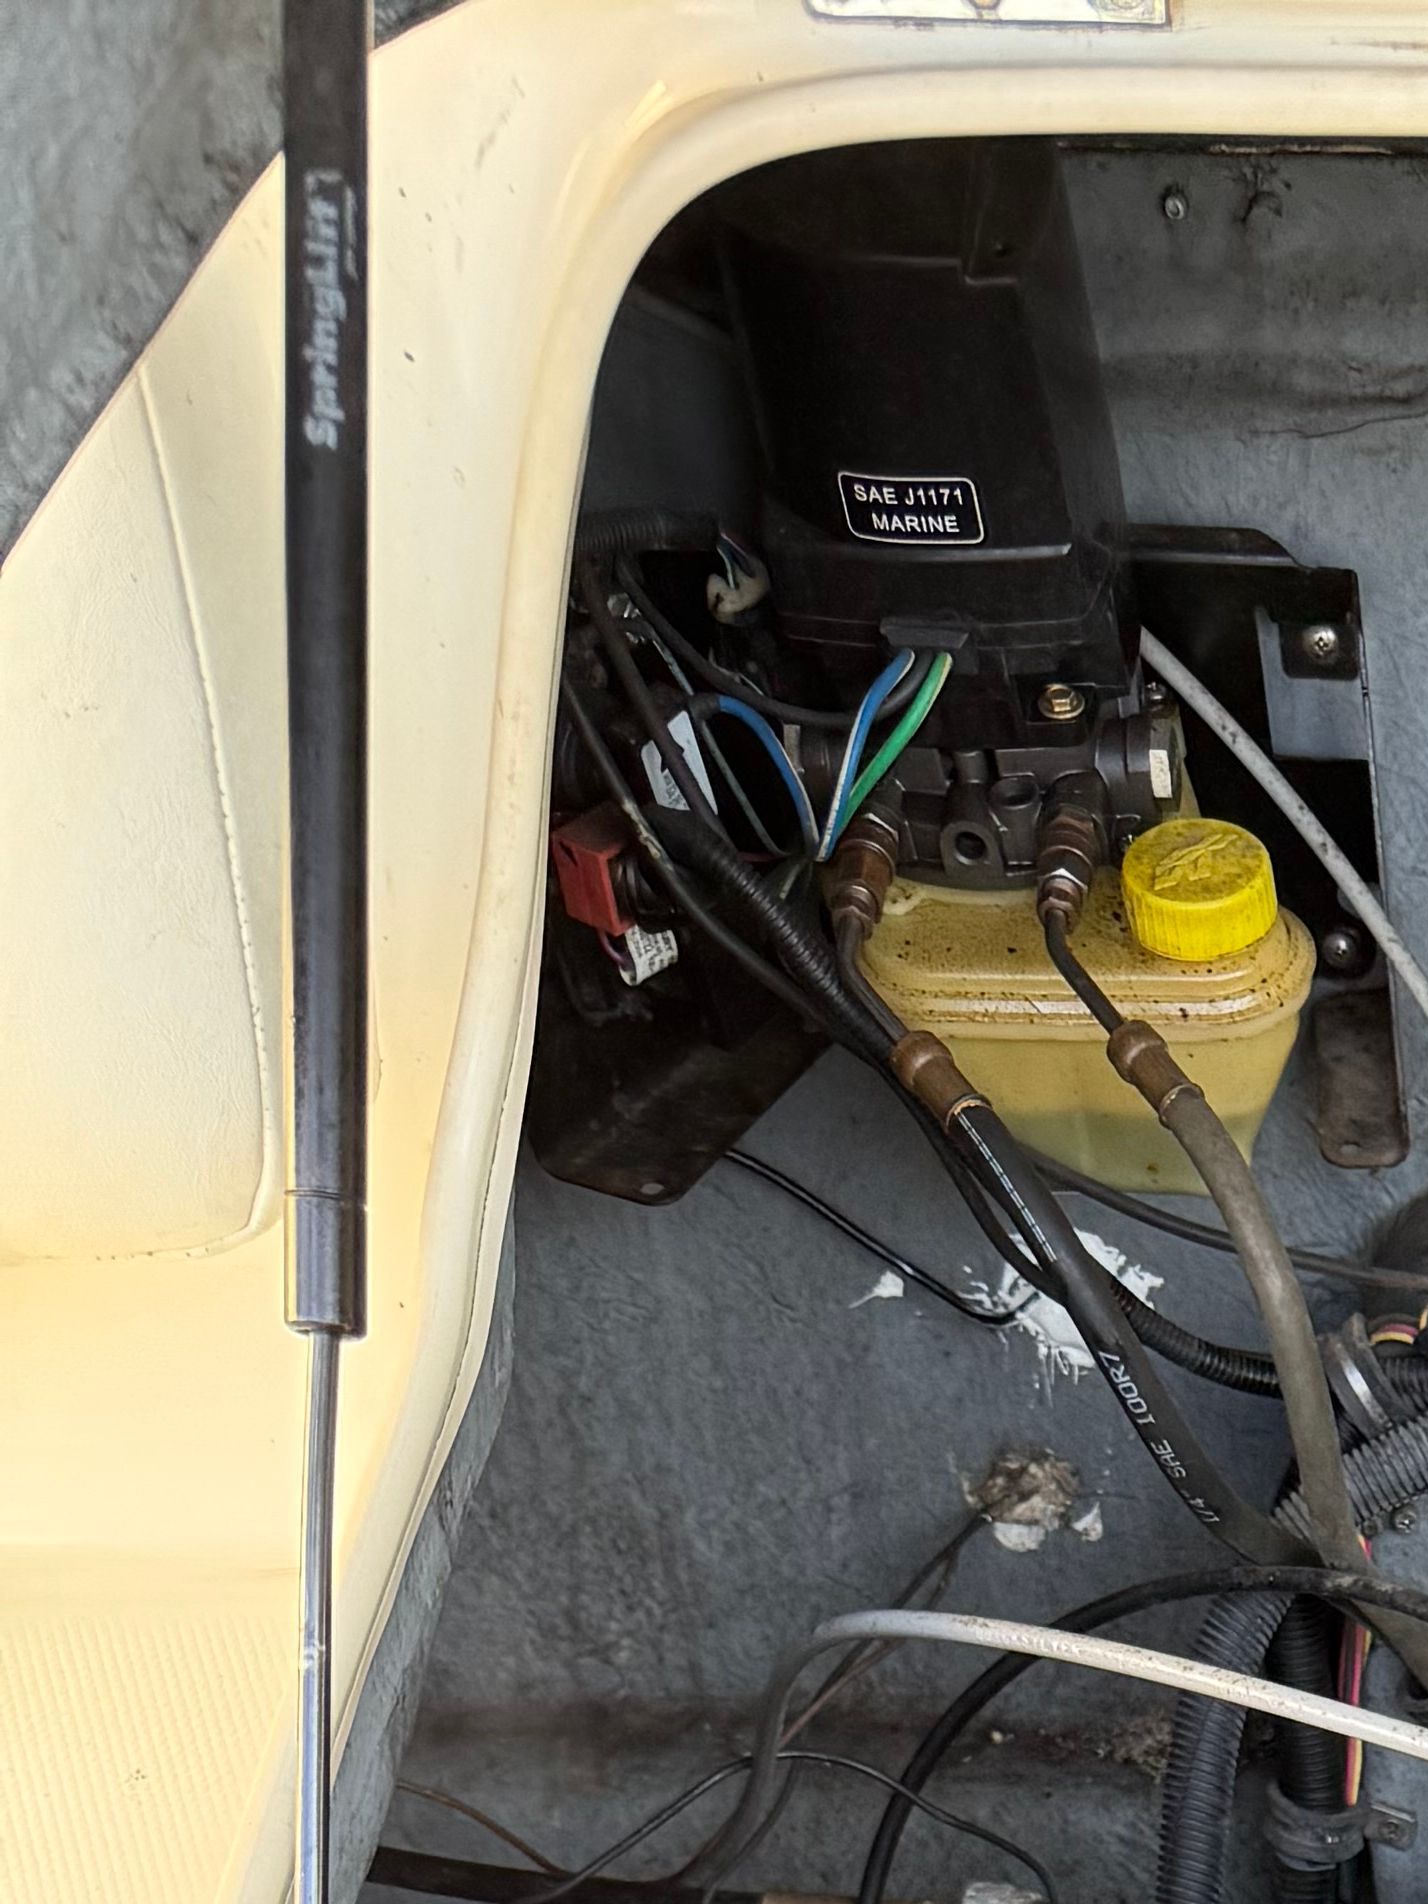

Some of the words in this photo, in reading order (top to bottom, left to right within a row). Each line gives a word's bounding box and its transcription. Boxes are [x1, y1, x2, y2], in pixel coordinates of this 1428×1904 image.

[854, 484, 894, 502] SAE
[906, 488, 963, 506] J1171
[872, 513, 960, 533] MARINE
[1098, 1352, 1156, 1425] 100R7
[1151, 1440, 1186, 1478] SAE
